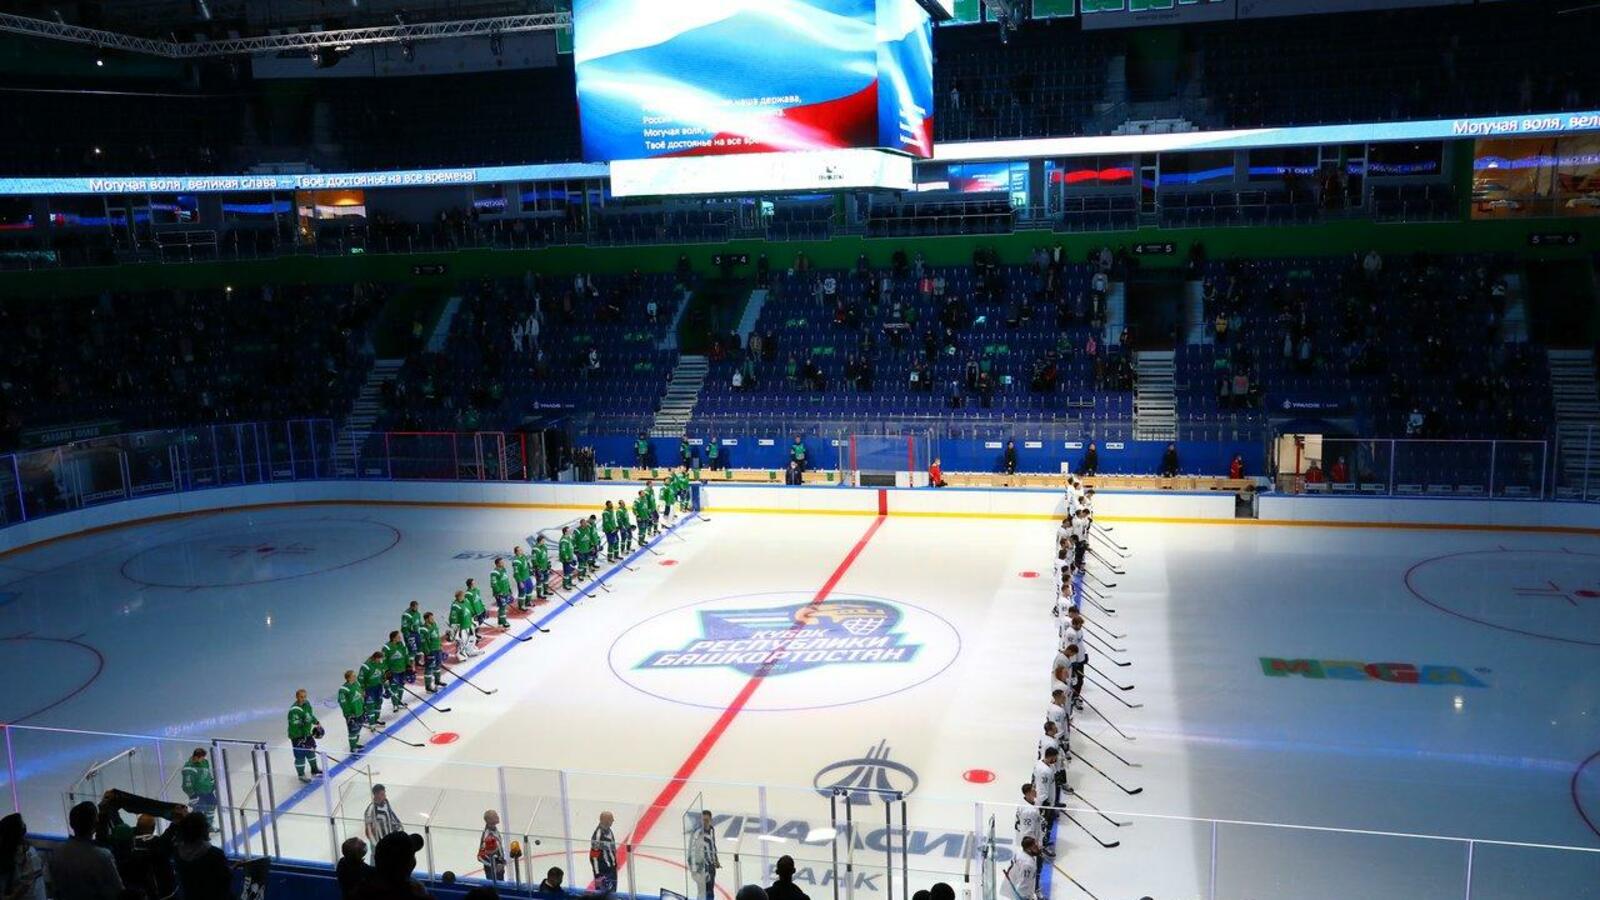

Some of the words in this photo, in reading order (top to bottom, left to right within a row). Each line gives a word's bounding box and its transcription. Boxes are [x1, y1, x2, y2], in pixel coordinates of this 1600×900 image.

[1453, 119, 1518, 135] Могучая
[1522, 118, 1566, 131] воля,
[1569, 115, 1600, 128] вел
[644, 127, 680, 138] Могучая
[645, 140, 666, 150] Твоё
[667, 138, 712, 150] достоянье
[714, 138, 725, 146] на
[727, 137, 743, 146] все
[91, 178, 146, 193] Могучая
[150, 178, 187, 192] воля,
[189, 178, 240, 191] великая
[242, 177, 277, 190] слава
[297, 175, 325, 187] Твоё
[328, 174, 386, 187] достоянье
[389, 175, 401, 185] на
[404, 174, 423, 185] все
[425, 168, 477, 186] времена!
[1135, 244, 1143, 254] 4
[1165, 244, 1173, 253] 5
[740, 255, 747, 264] 4
[751, 629, 831, 640] КУБОК
[687, 637, 893, 654] РЕСПУБЛИКИ
[652, 648, 906, 667] БАШКОРТОСТАН
